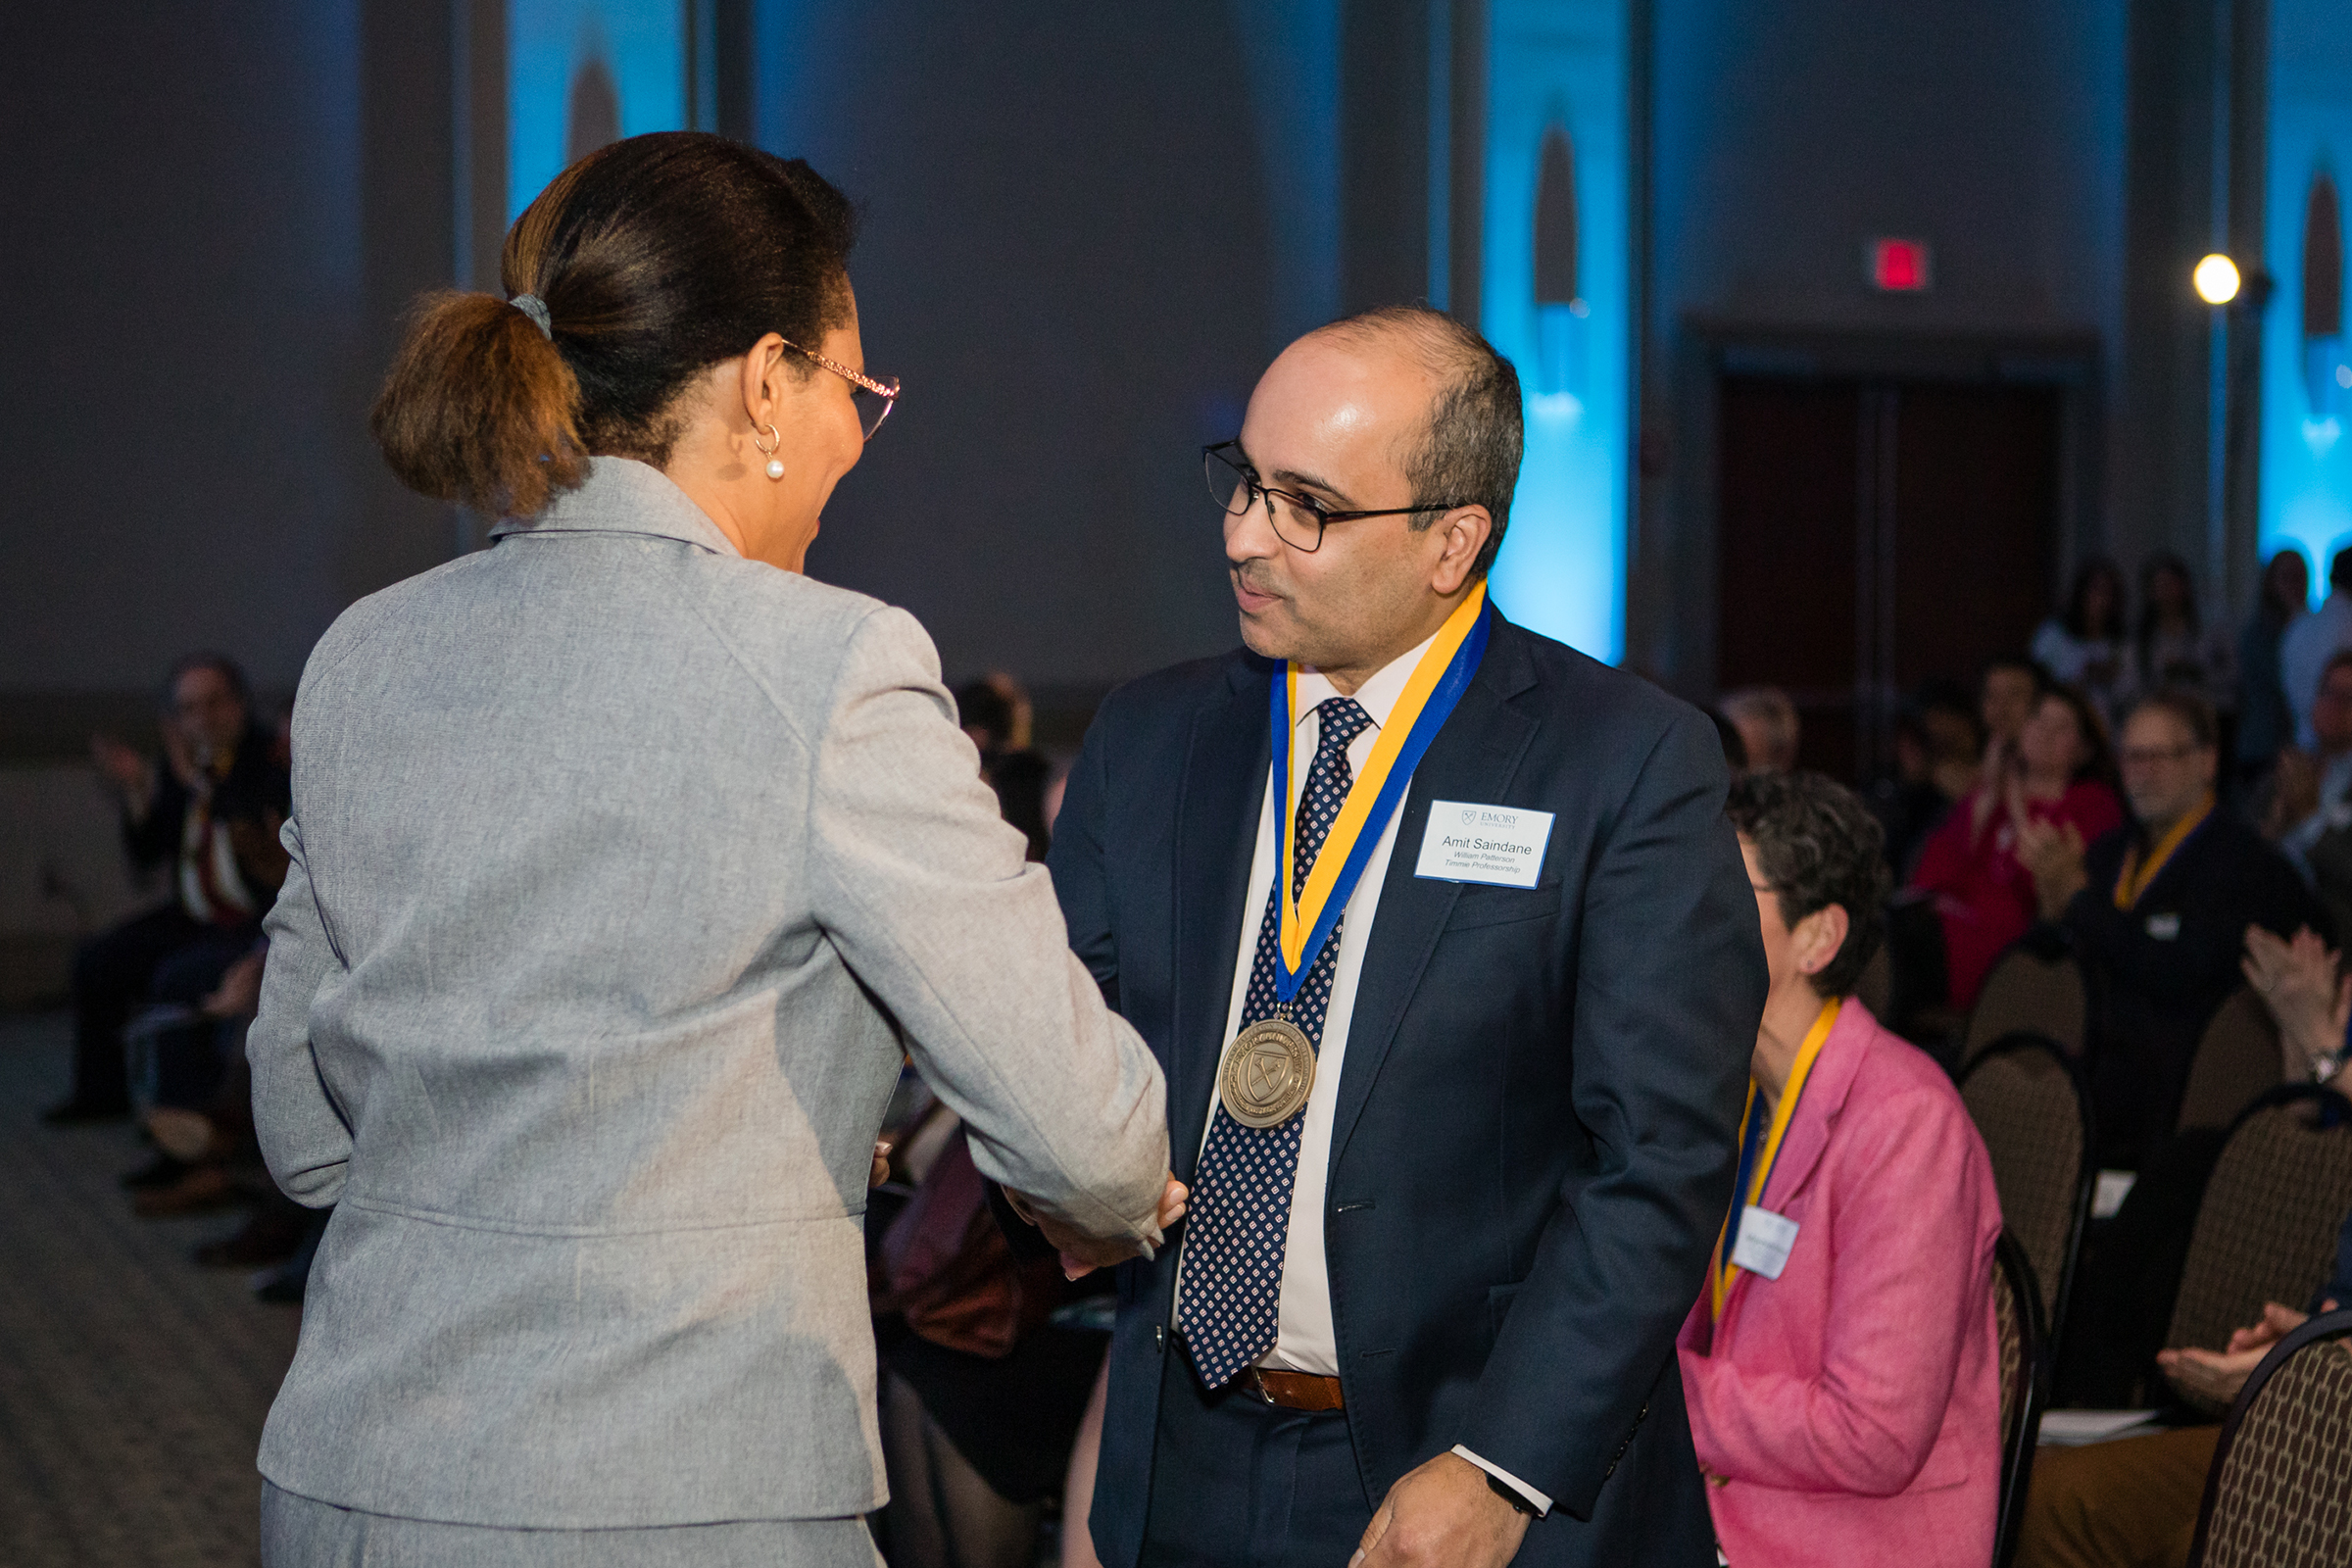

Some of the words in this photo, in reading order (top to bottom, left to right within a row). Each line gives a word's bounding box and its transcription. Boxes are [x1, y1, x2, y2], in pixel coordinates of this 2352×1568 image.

[1481, 812, 1518, 824] EMORY
[1442, 836, 1470, 848] Amit
[1473, 838, 1532, 856] Saindane
[1453, 851, 1479, 859] William
[1481, 854, 1515, 863] Patterson
[1471, 861, 1521, 874] Professorship
